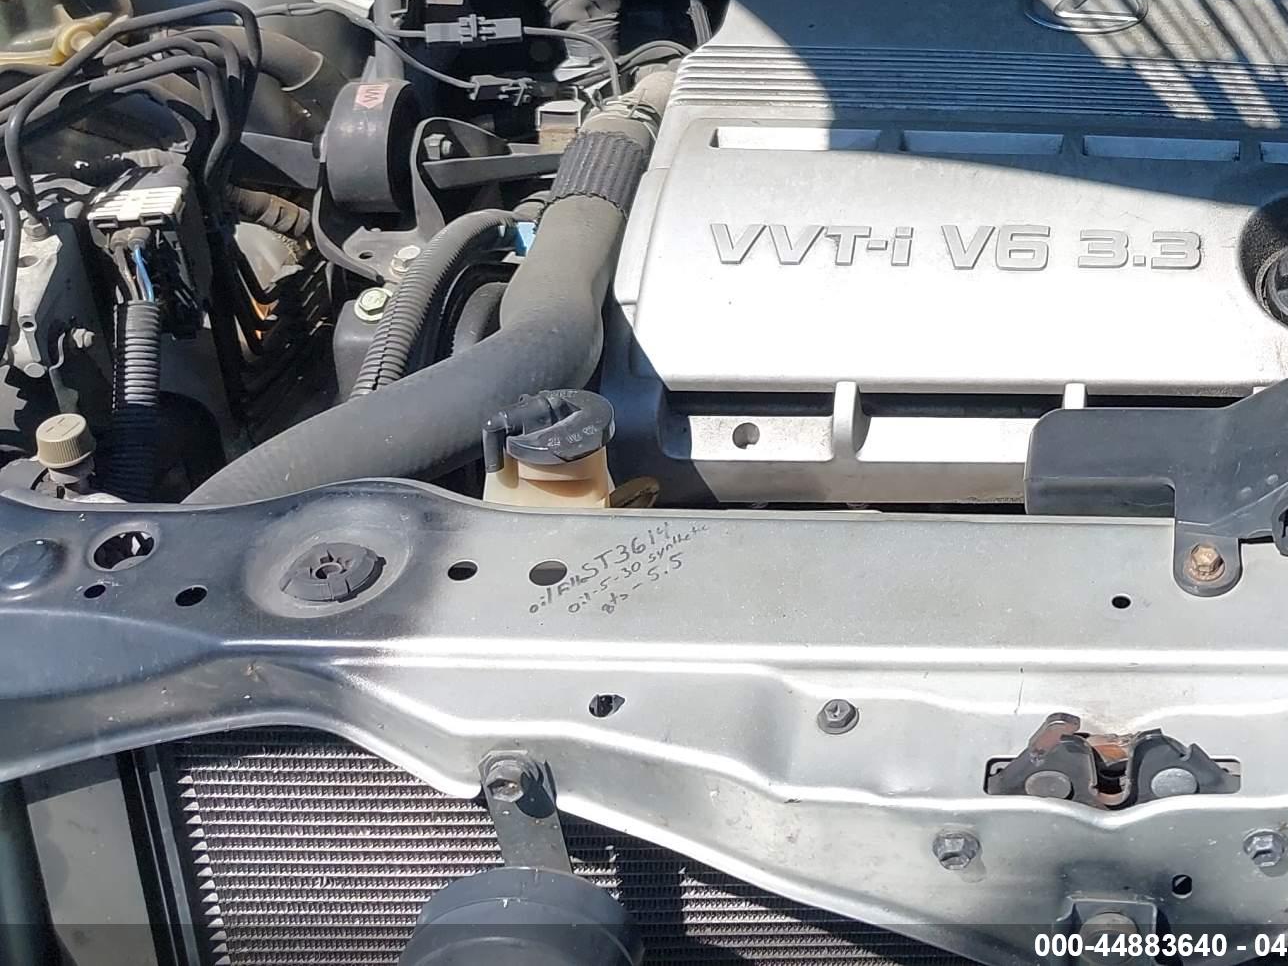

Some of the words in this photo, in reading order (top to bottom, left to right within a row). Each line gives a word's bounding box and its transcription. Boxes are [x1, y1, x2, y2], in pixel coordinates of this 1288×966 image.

[711, 224, 914, 265] VVT-i
[941, 224, 1051, 270] V6
[1078, 229, 1202, 270] 3.3
[647, 552, 684, 582] 5.5
